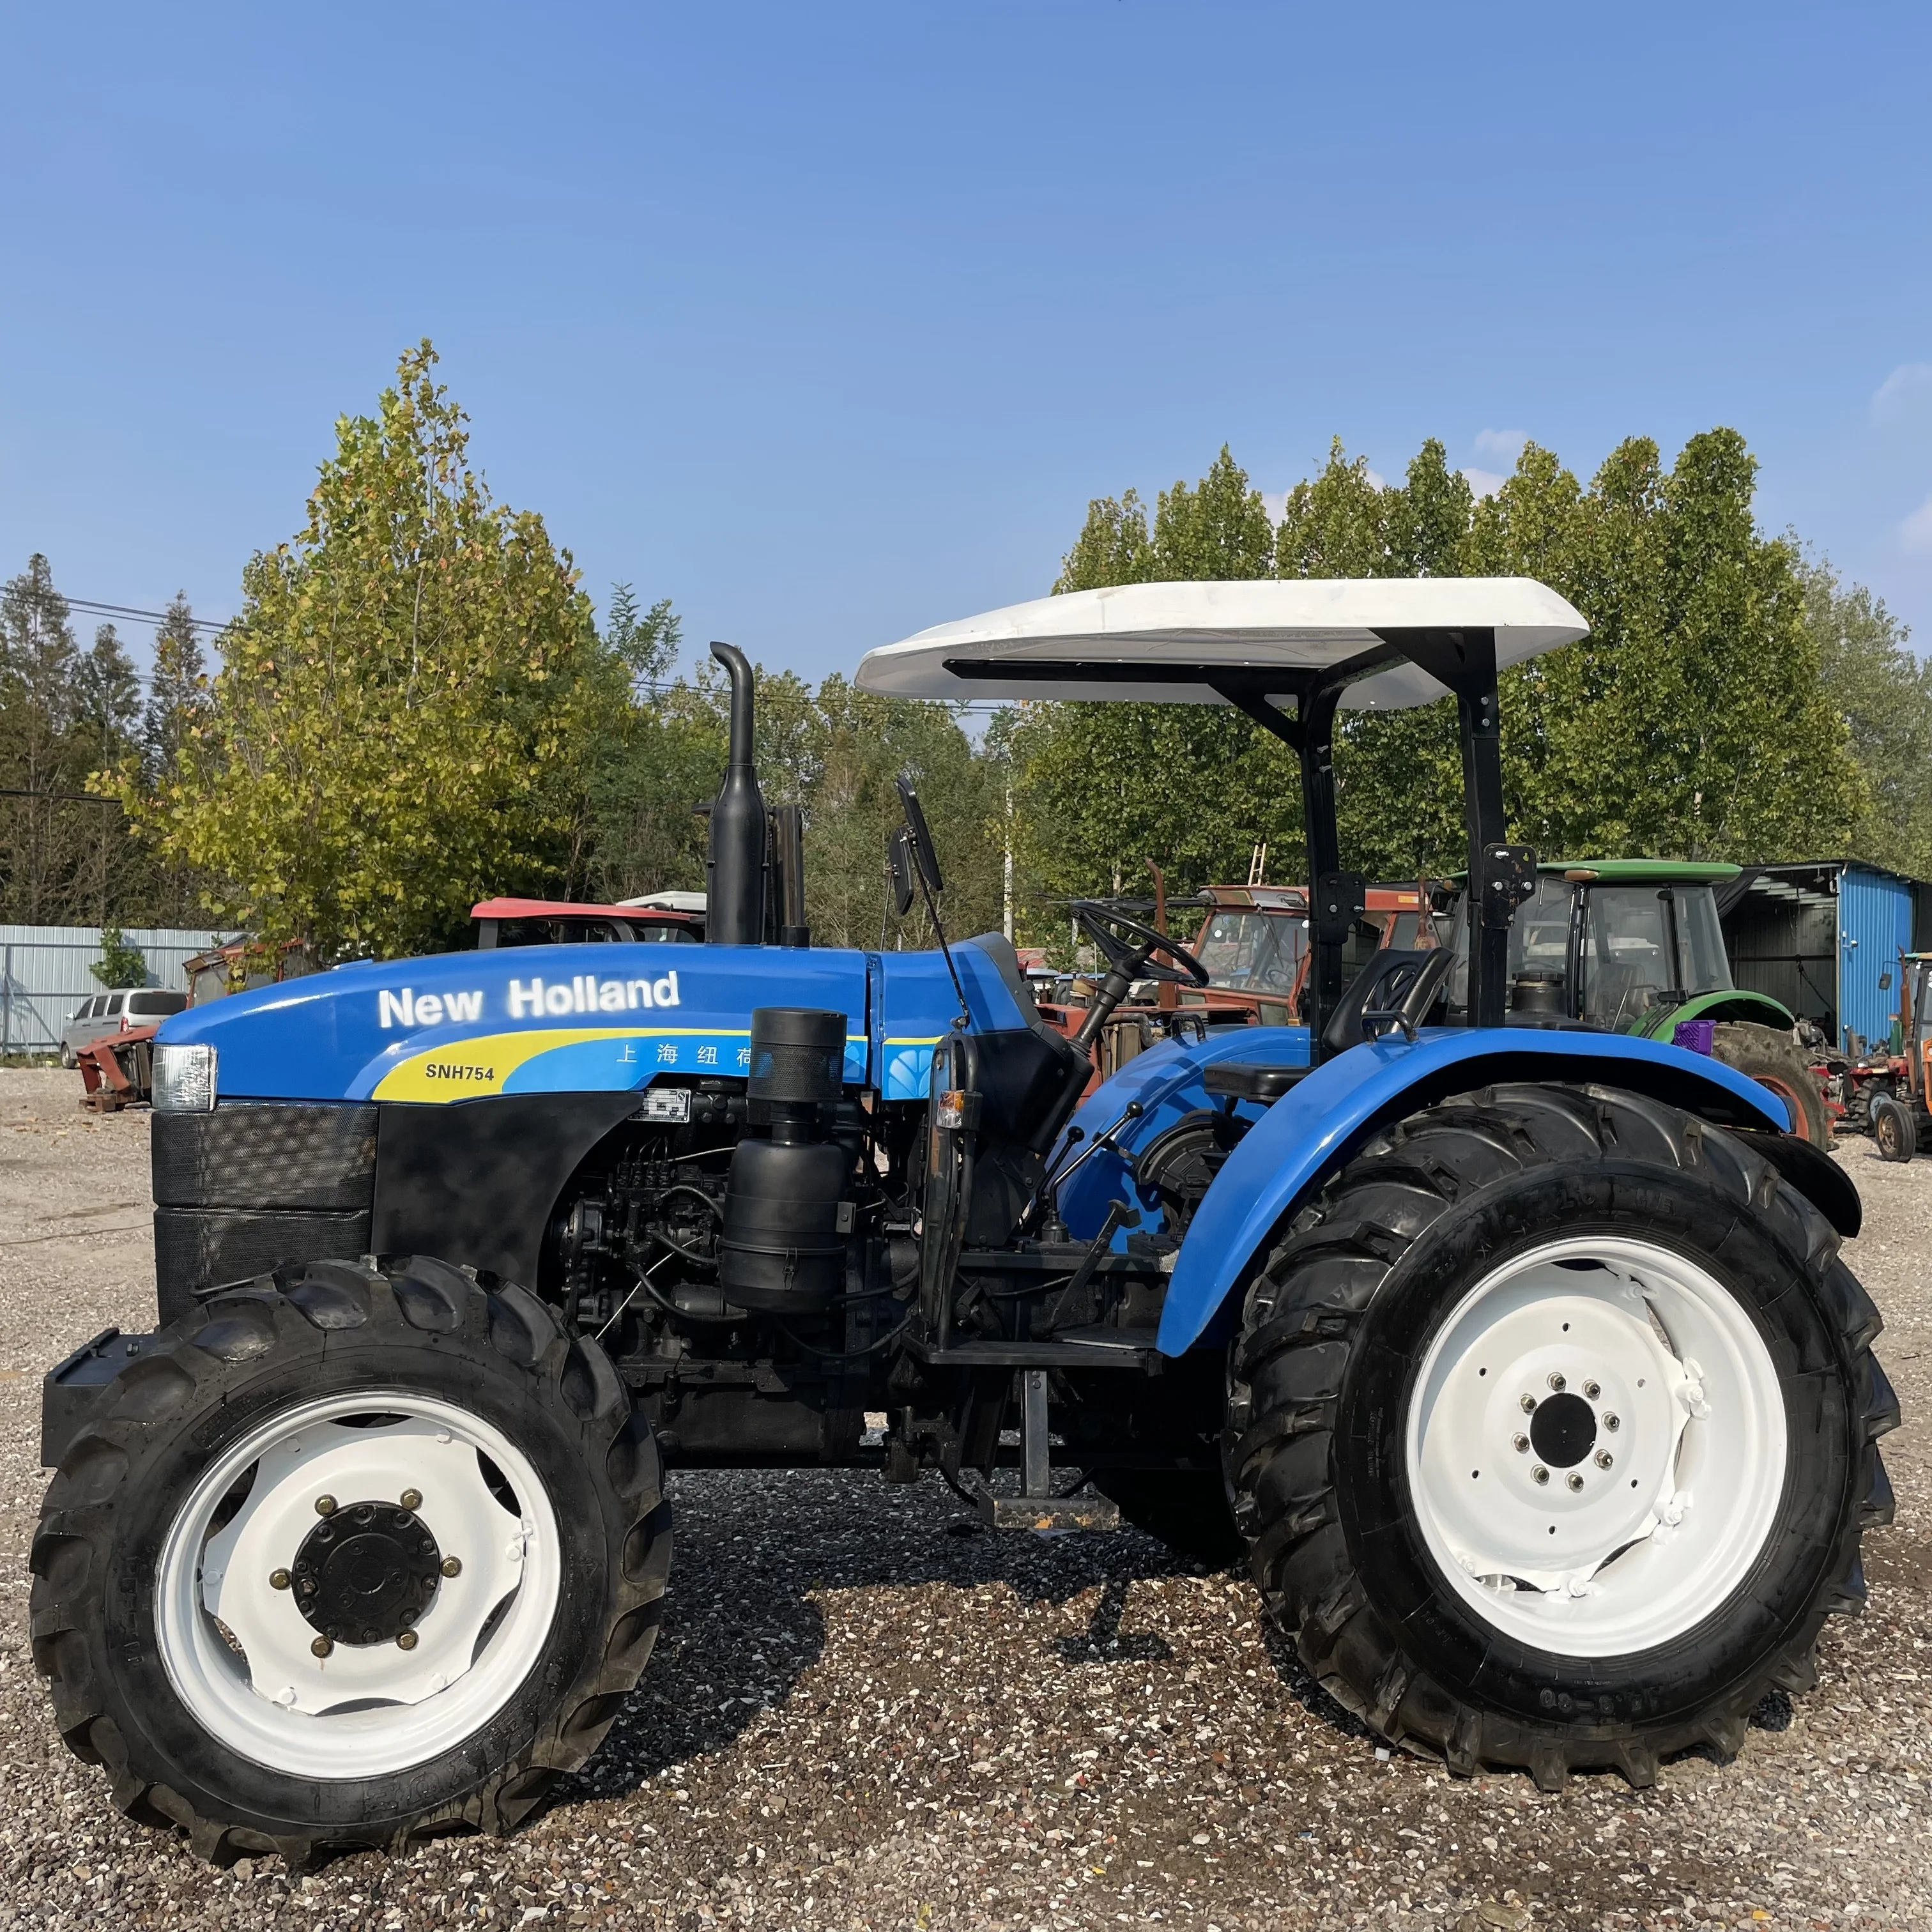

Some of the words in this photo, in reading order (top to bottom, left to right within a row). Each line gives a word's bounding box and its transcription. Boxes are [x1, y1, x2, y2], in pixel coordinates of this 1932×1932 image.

[379, 988, 483, 1029] New
[508, 970, 680, 1018] Holland
[425, 1063, 494, 1082] SNH754
